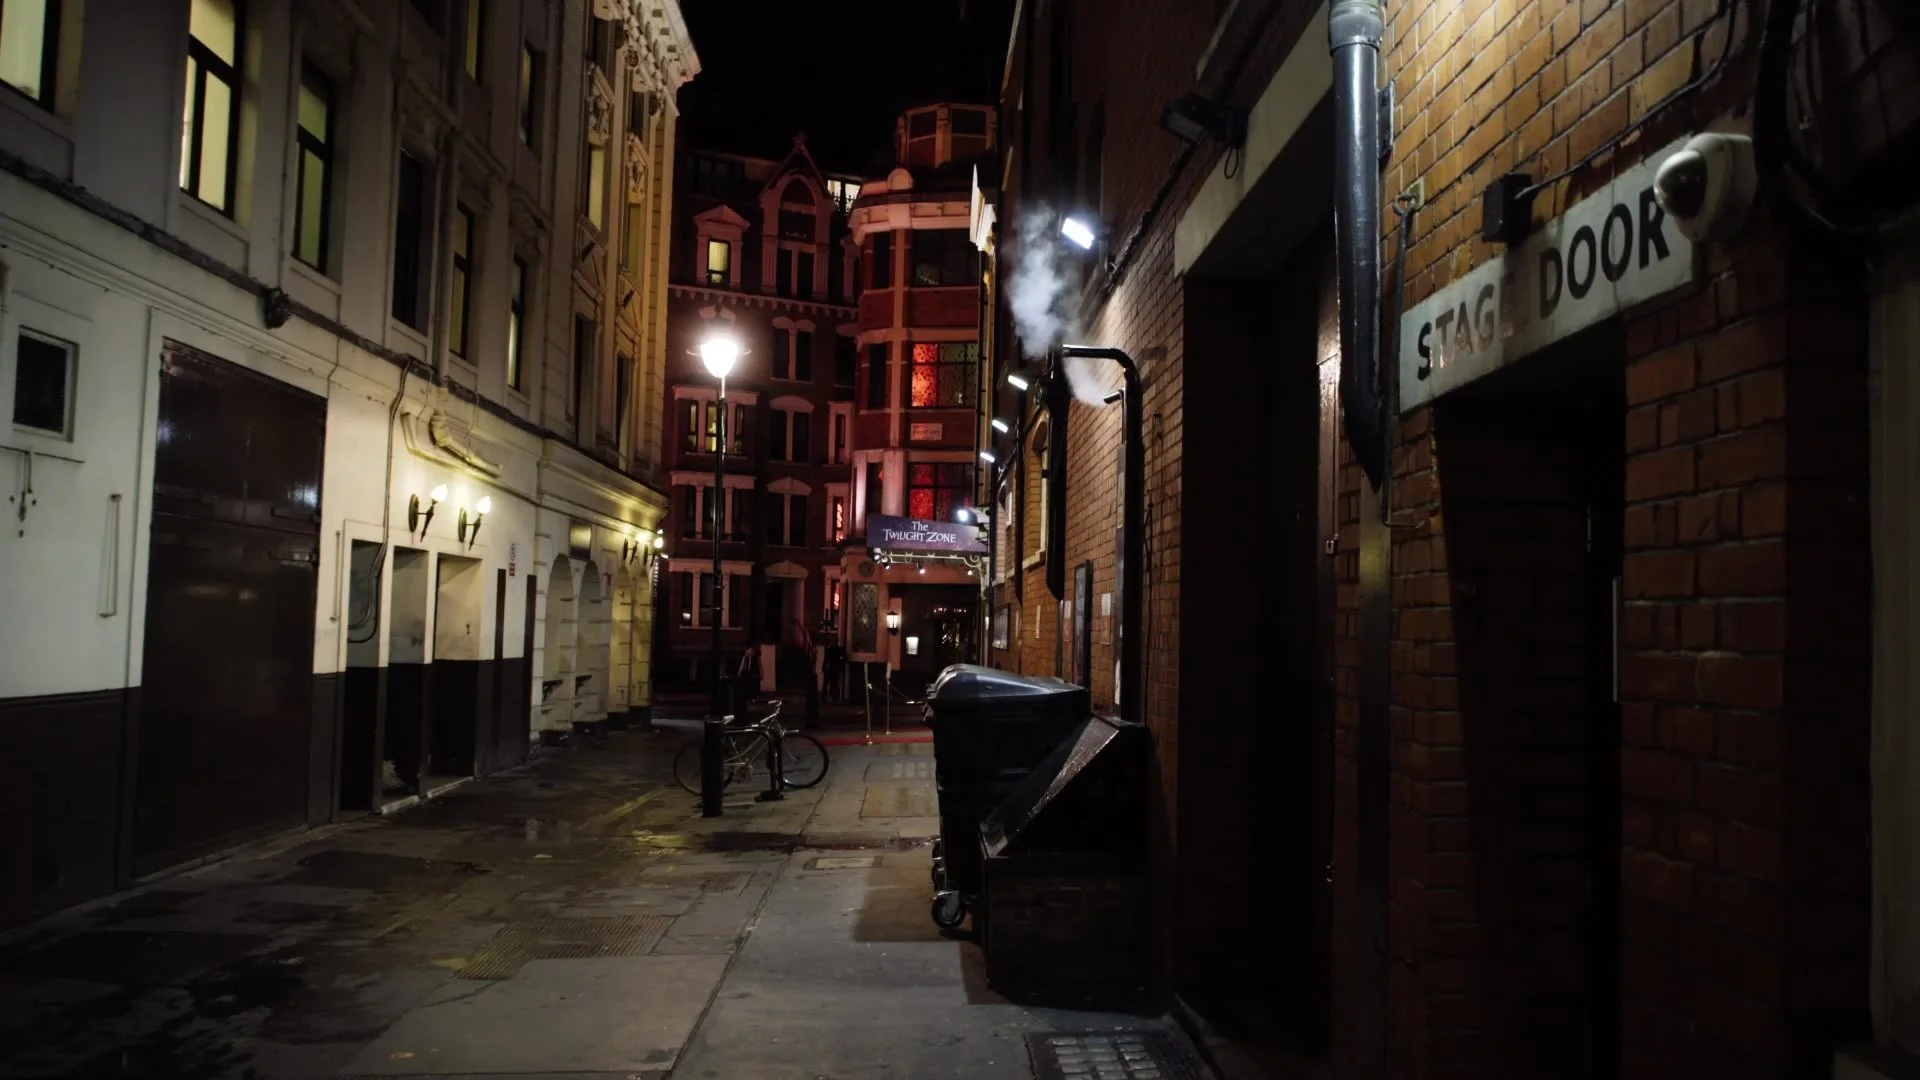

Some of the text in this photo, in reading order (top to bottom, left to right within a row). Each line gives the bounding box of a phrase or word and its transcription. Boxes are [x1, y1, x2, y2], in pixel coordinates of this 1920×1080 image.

[1539, 185, 1670, 320] DOOR
[911, 521, 928, 532] The
[926, 532, 957, 543] ZONE
